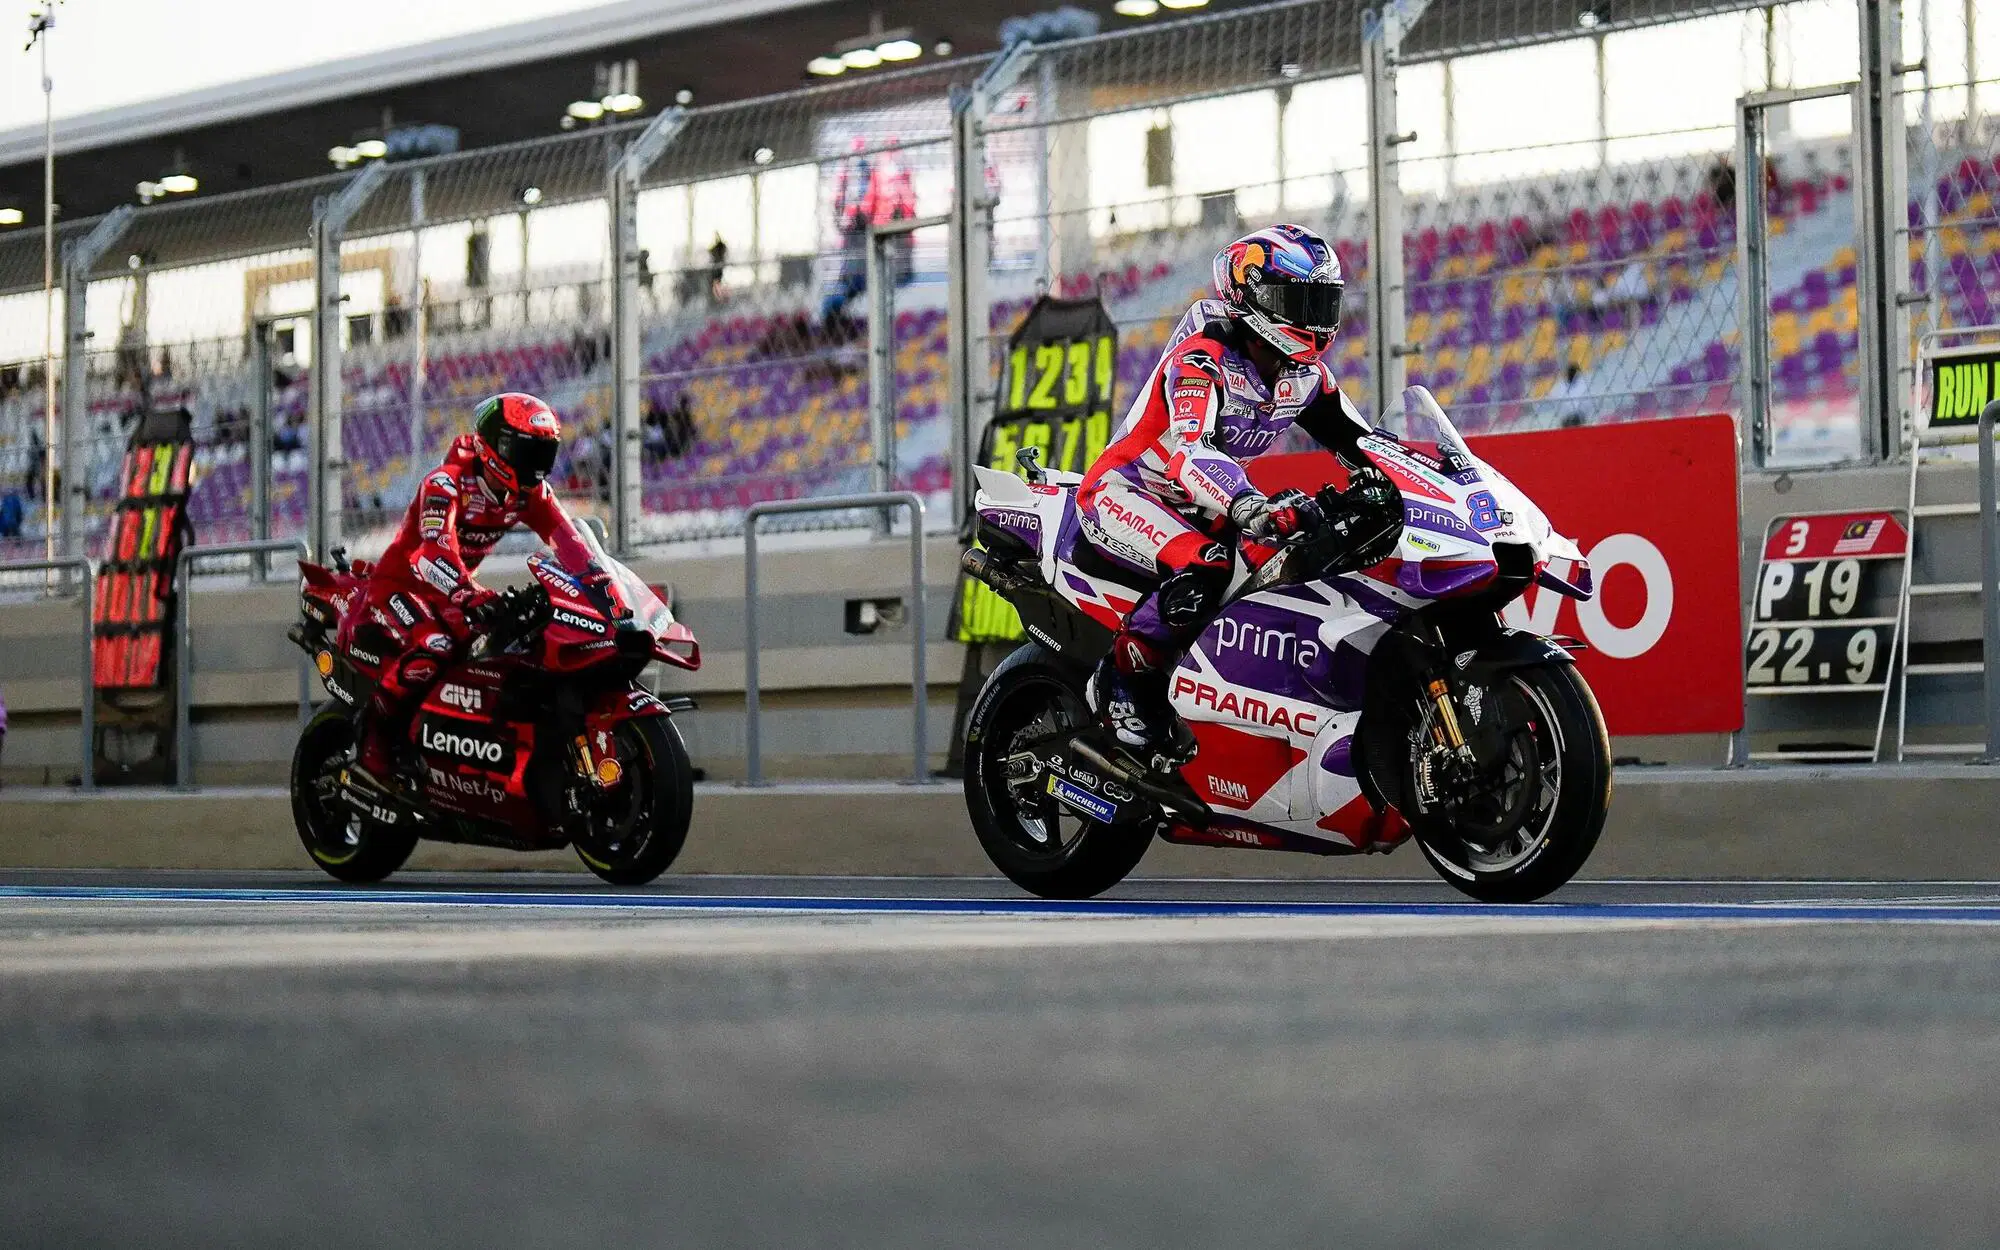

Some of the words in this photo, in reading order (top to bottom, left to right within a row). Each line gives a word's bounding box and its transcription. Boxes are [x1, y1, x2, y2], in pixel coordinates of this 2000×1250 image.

[1173, 389, 1206, 400] MOTUL
[1936, 362, 1988, 419] RUN
[1411, 450, 1441, 470] MOTUL
[1206, 463, 1236, 491] prima
[1375, 456, 1441, 497] PRAMAC
[998, 512, 1040, 531] prima
[1098, 496, 1168, 546] PRAMAC
[1406, 506, 1468, 532] prima
[1081, 516, 1155, 570] alpinestars
[1785, 520, 1810, 555] 3
[435, 558, 459, 578] Lenovo
[544, 573, 580, 598] riello
[389, 594, 415, 626] Lenovo
[552, 608, 606, 634] Lenovo
[349, 643, 380, 665] Lenovo
[1213, 617, 1320, 669] prima
[439, 683, 482, 713] GIVI
[975, 684, 1002, 726] MICHELIN
[1172, 675, 1317, 738] PRAMAC
[422, 723, 502, 763] Lenovo
[1072, 768, 1095, 785] AFAM
[1207, 774, 1249, 800] FIAMM
[1064, 789, 1108, 816] MICHELIN
